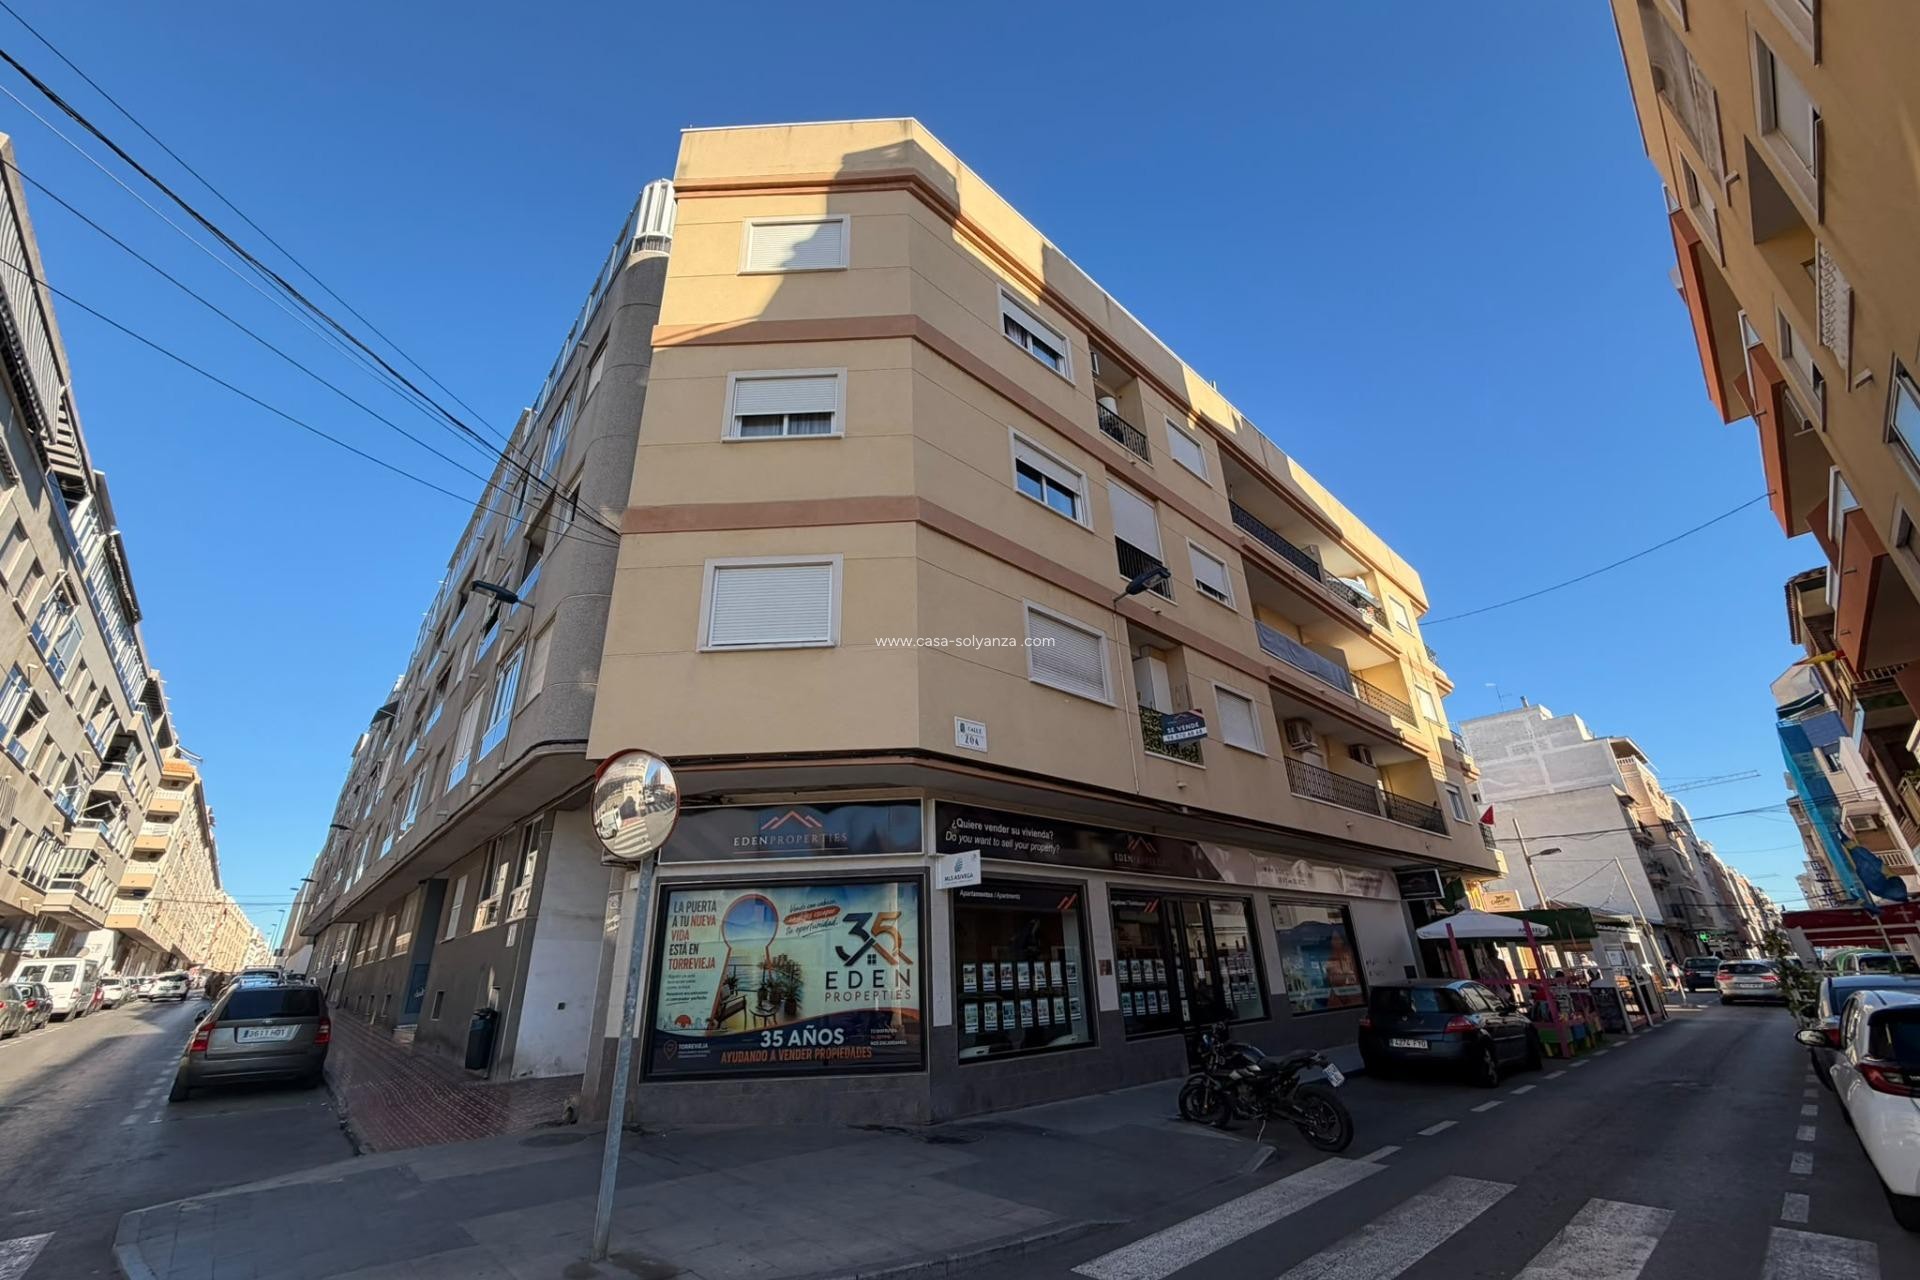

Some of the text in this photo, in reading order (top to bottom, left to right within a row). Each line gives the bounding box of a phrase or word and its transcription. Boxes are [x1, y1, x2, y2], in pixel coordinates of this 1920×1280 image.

[1176, 721, 1200, 732] VENDE
[951, 818, 1054, 840] ¿Quiere vender su vivienda?
[945, 831, 1061, 856] Do you want to sell your property?
[673, 900, 717, 914] LA PUERTA
[672, 915, 717, 927] A TU NUEVA
[671, 930, 690, 942] VIDA
[835, 912, 908, 966] 35
[669, 942, 699, 956] ESTÁ EN
[668, 957, 716, 970] TORREVIEJA
[825, 969, 911, 990] EDEN
[825, 990, 911, 1002] PROPERTIES
[760, 1024, 845, 1048] 35 AÑOS
[721, 1046, 873, 1063] AYUDANDO A VENDER PROPIEDADES
